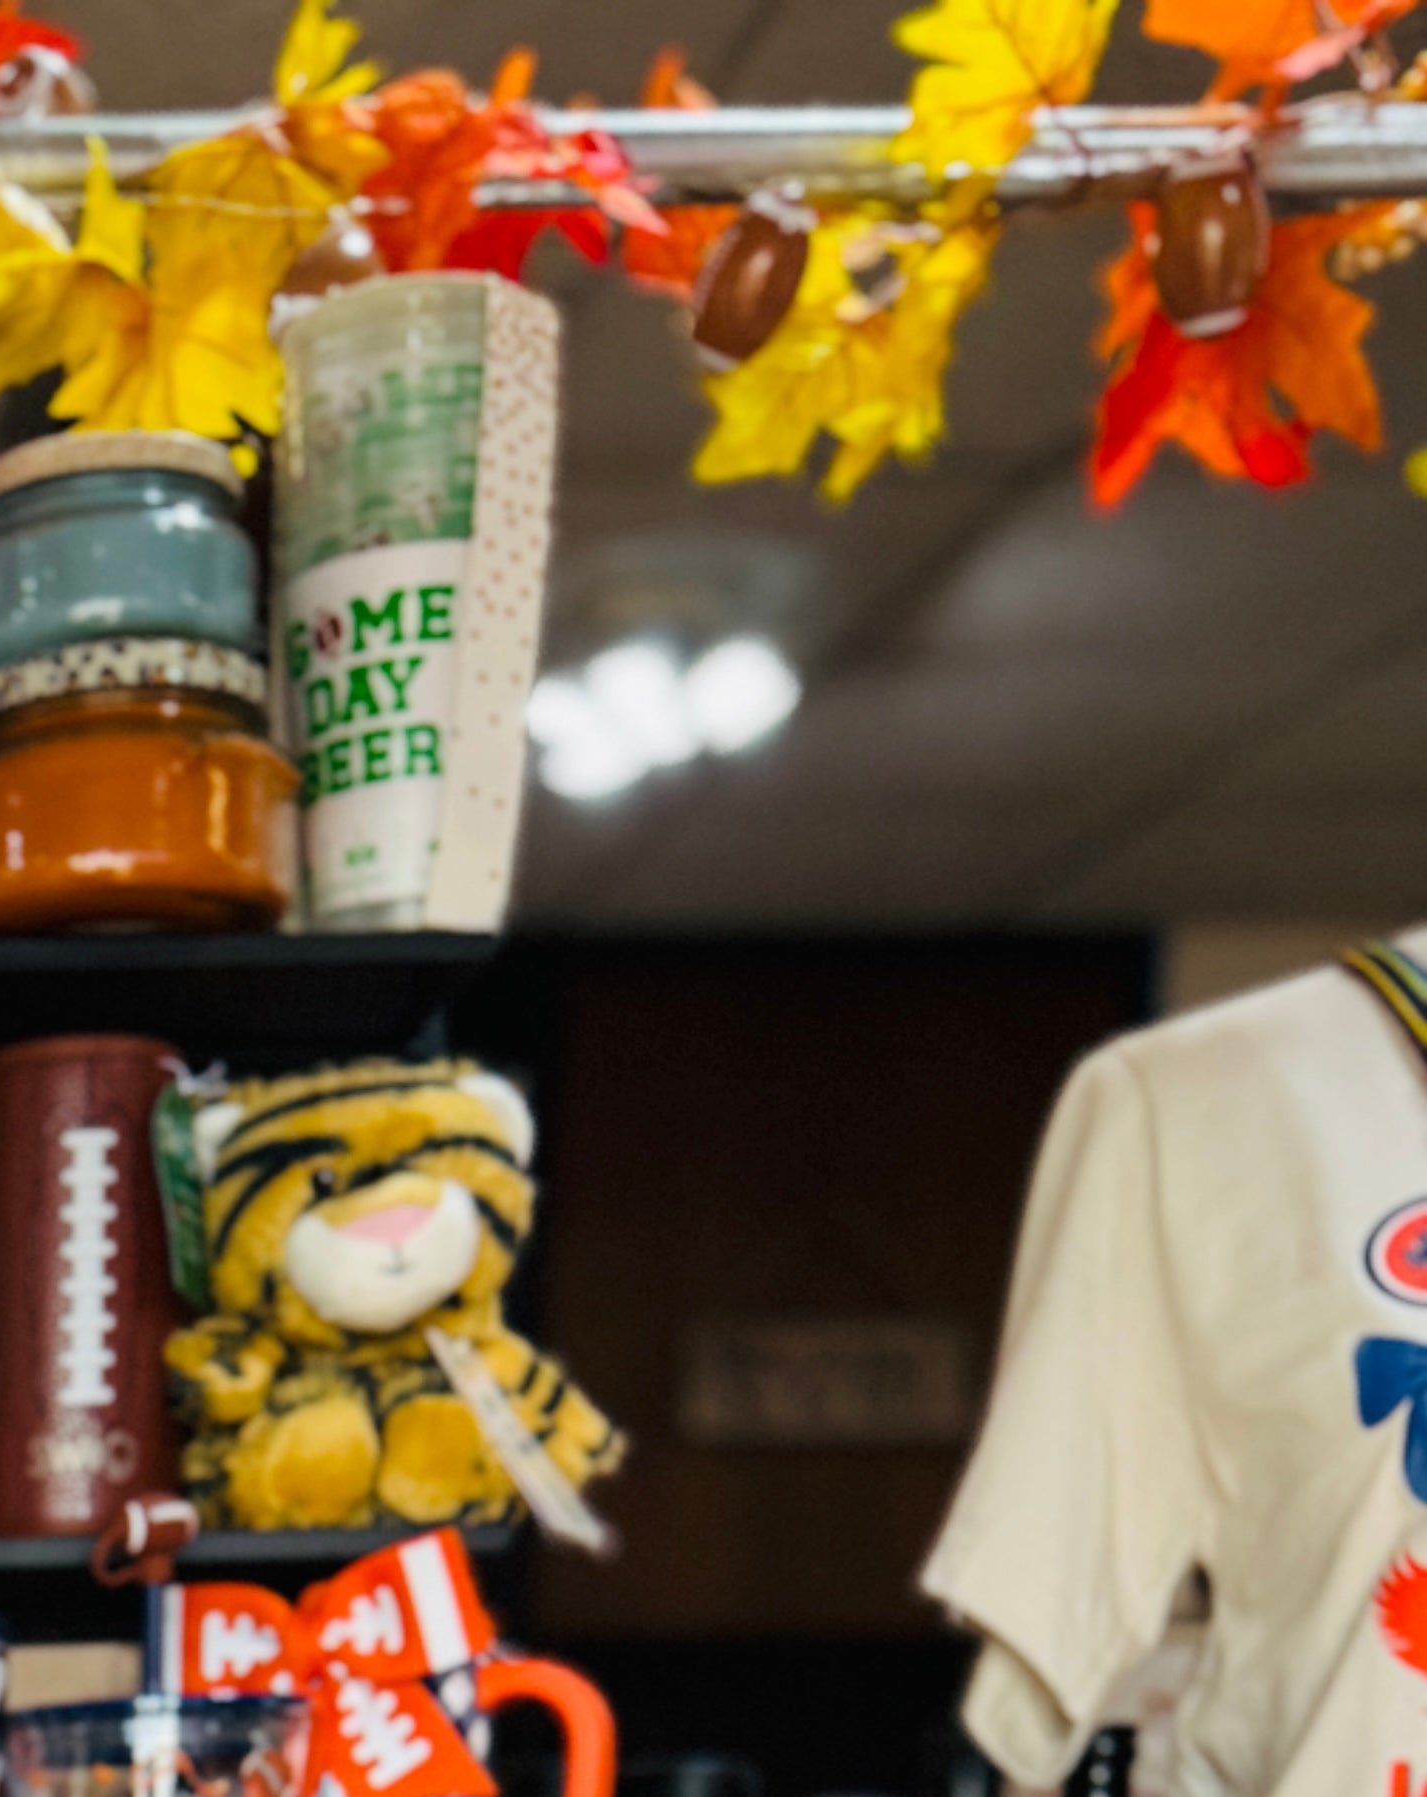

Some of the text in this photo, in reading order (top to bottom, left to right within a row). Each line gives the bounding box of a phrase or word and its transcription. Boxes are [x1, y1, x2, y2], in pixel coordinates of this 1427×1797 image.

[288, 584, 456, 680] GME
[304, 654, 425, 737] DAY
[298, 722, 443, 810] BEER
